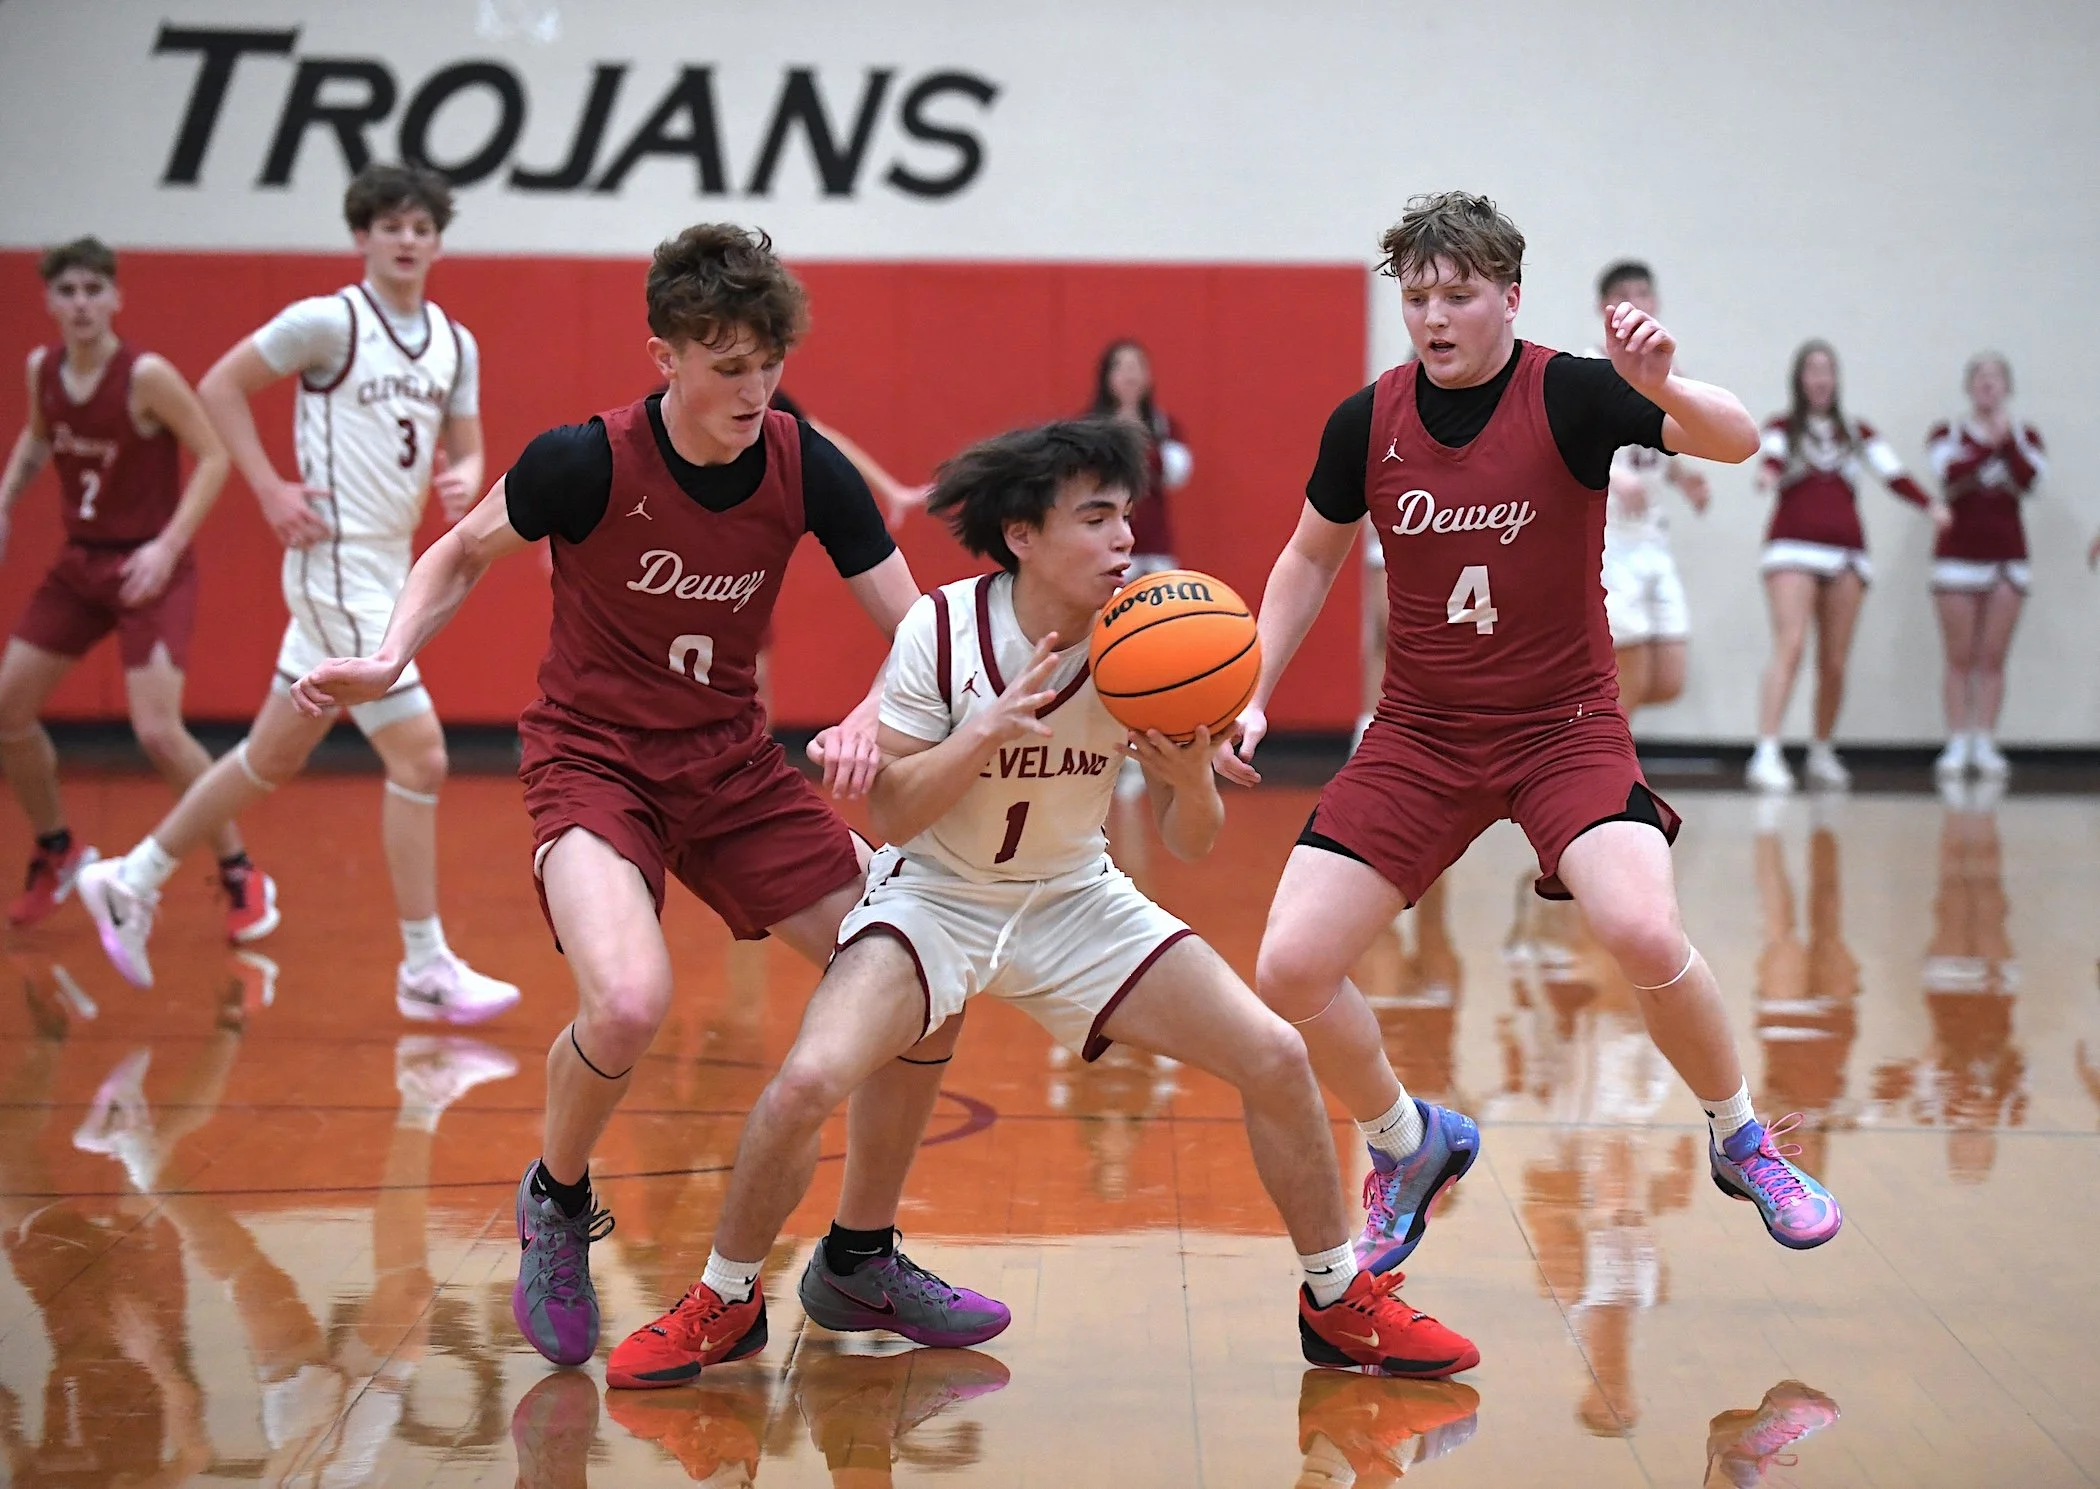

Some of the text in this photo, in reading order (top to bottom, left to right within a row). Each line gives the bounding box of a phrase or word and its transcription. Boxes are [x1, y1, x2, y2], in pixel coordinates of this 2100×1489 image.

[151, 23, 1001, 200] TROJANS
[357, 374, 446, 407] CLEVELAN
[397, 418, 417, 469] 3
[79, 469, 101, 520] 2
[1391, 489, 1537, 545] Dewey
[626, 549, 766, 614] Dewey
[1103, 582, 1214, 628] Wilson
[1446, 564, 1498, 635] 4
[994, 801, 1030, 864] 1
